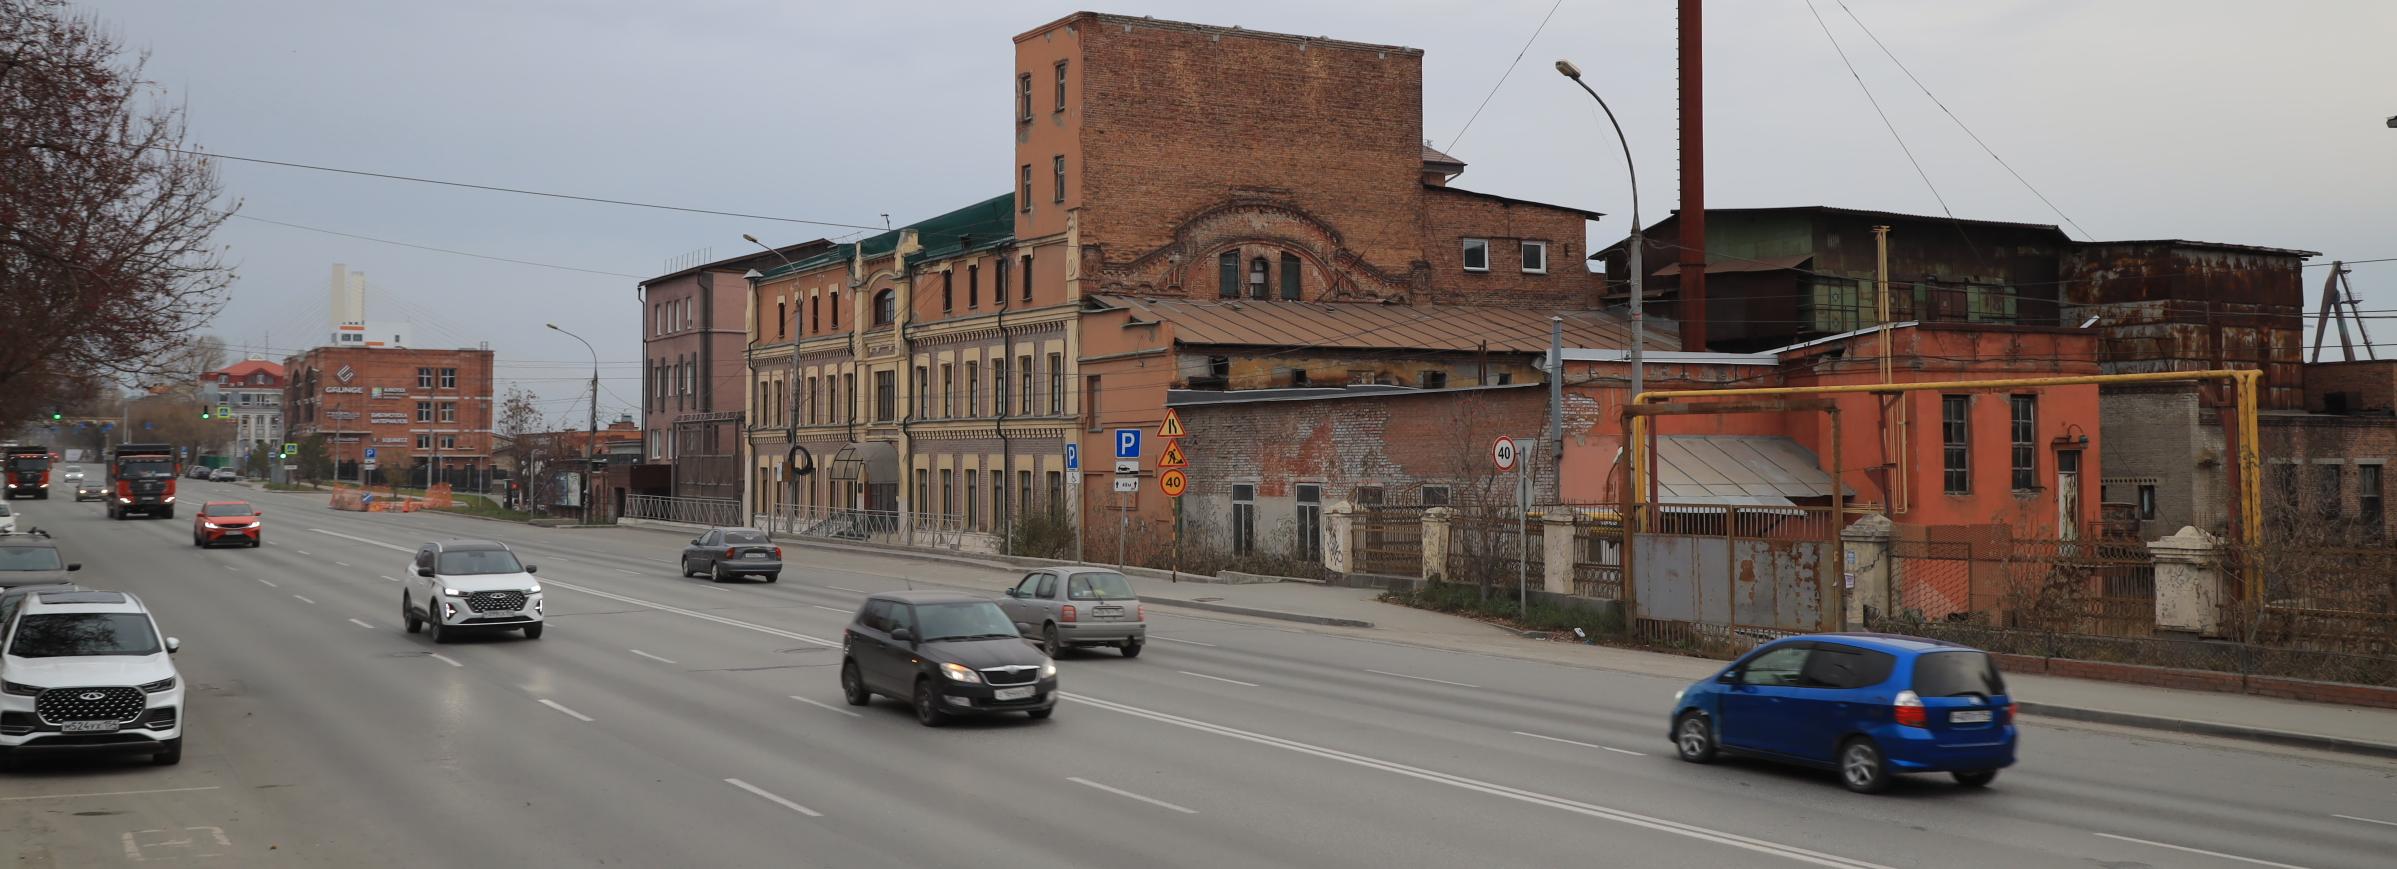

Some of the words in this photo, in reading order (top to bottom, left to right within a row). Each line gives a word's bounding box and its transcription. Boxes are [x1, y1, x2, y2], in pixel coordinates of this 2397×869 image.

[1121, 432, 1135, 455] P
[1068, 446, 1075, 466] P
[1498, 446, 1510, 459] 40
[1165, 476, 1181, 488] 40
